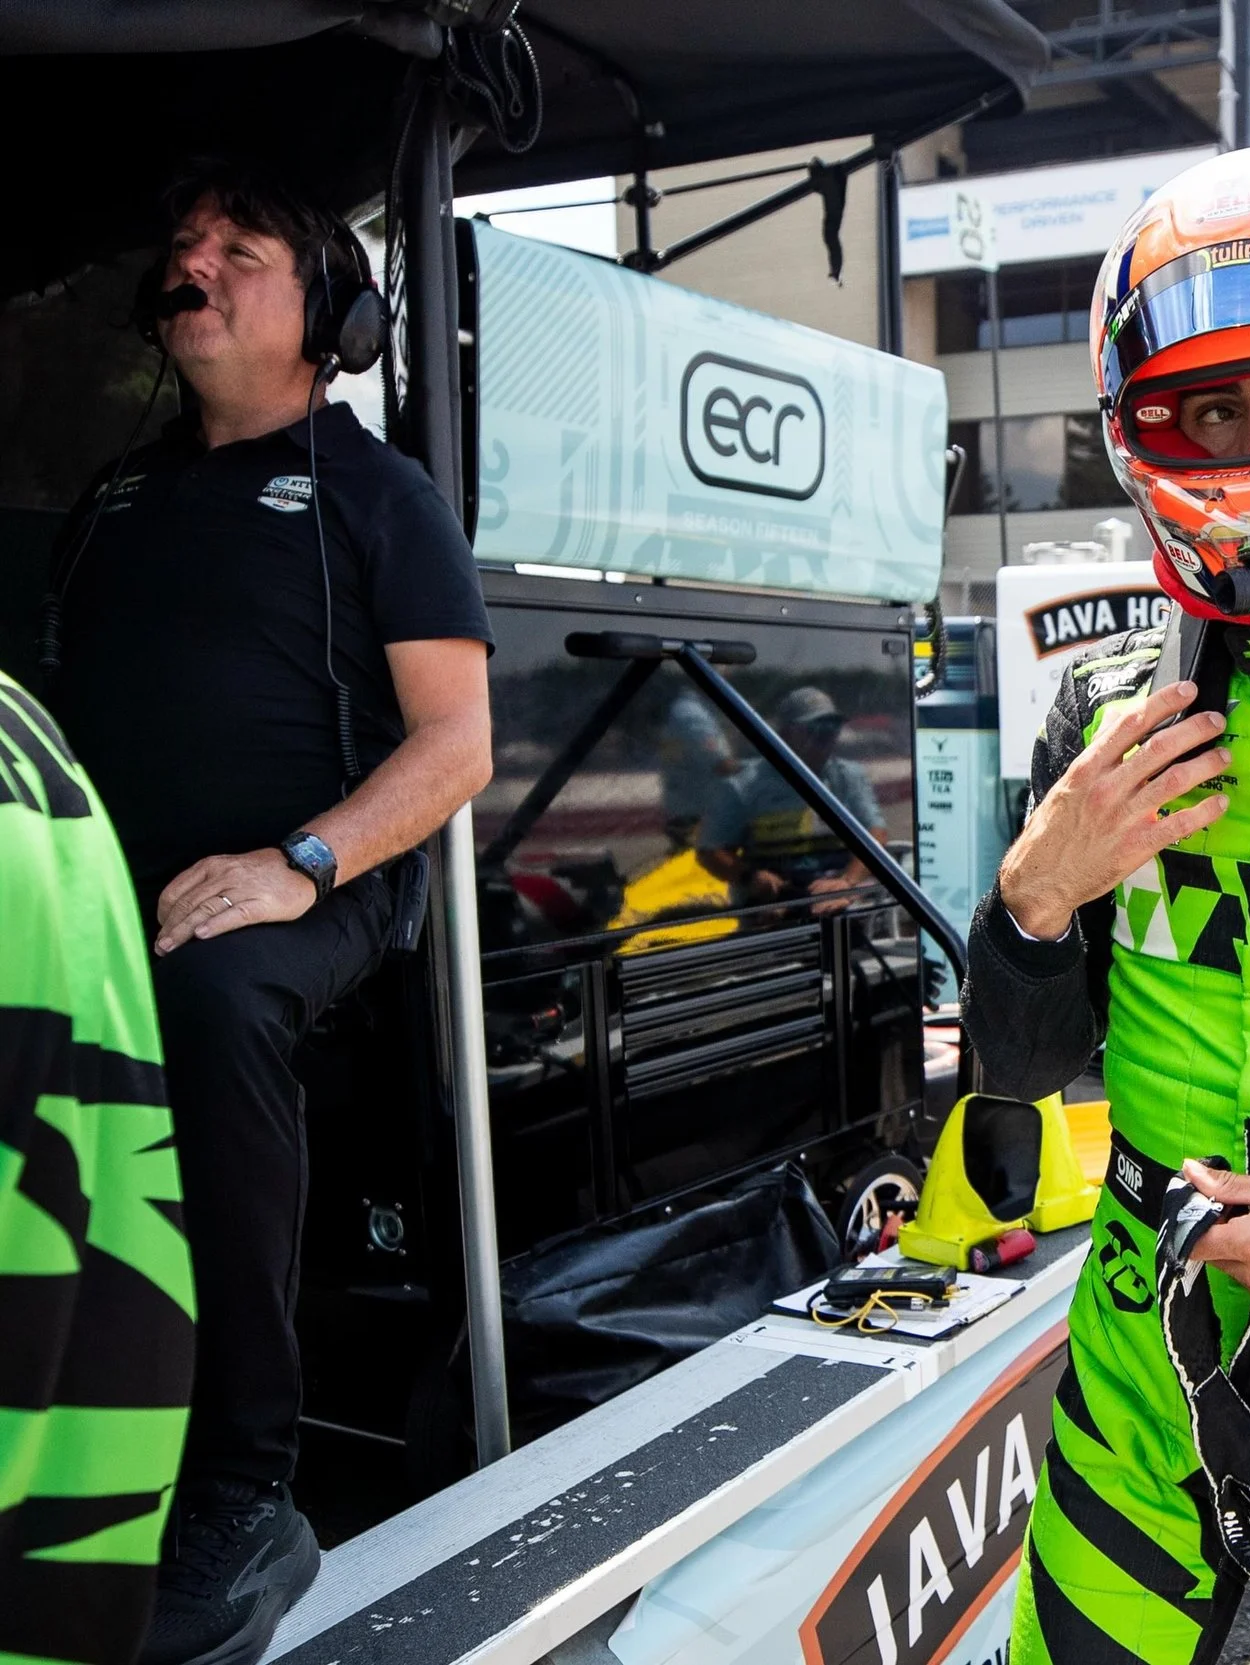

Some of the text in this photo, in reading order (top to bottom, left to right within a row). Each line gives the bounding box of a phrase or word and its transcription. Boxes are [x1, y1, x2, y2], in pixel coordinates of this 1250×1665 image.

[703, 386, 806, 467] ecr
[1140, 409, 1169, 418] BELL
[1169, 544, 1197, 567] BELL
[1043, 599, 1117, 647] JAVA
[1117, 1153, 1144, 1193] OMP
[866, 1412, 1037, 1665] JAVA
